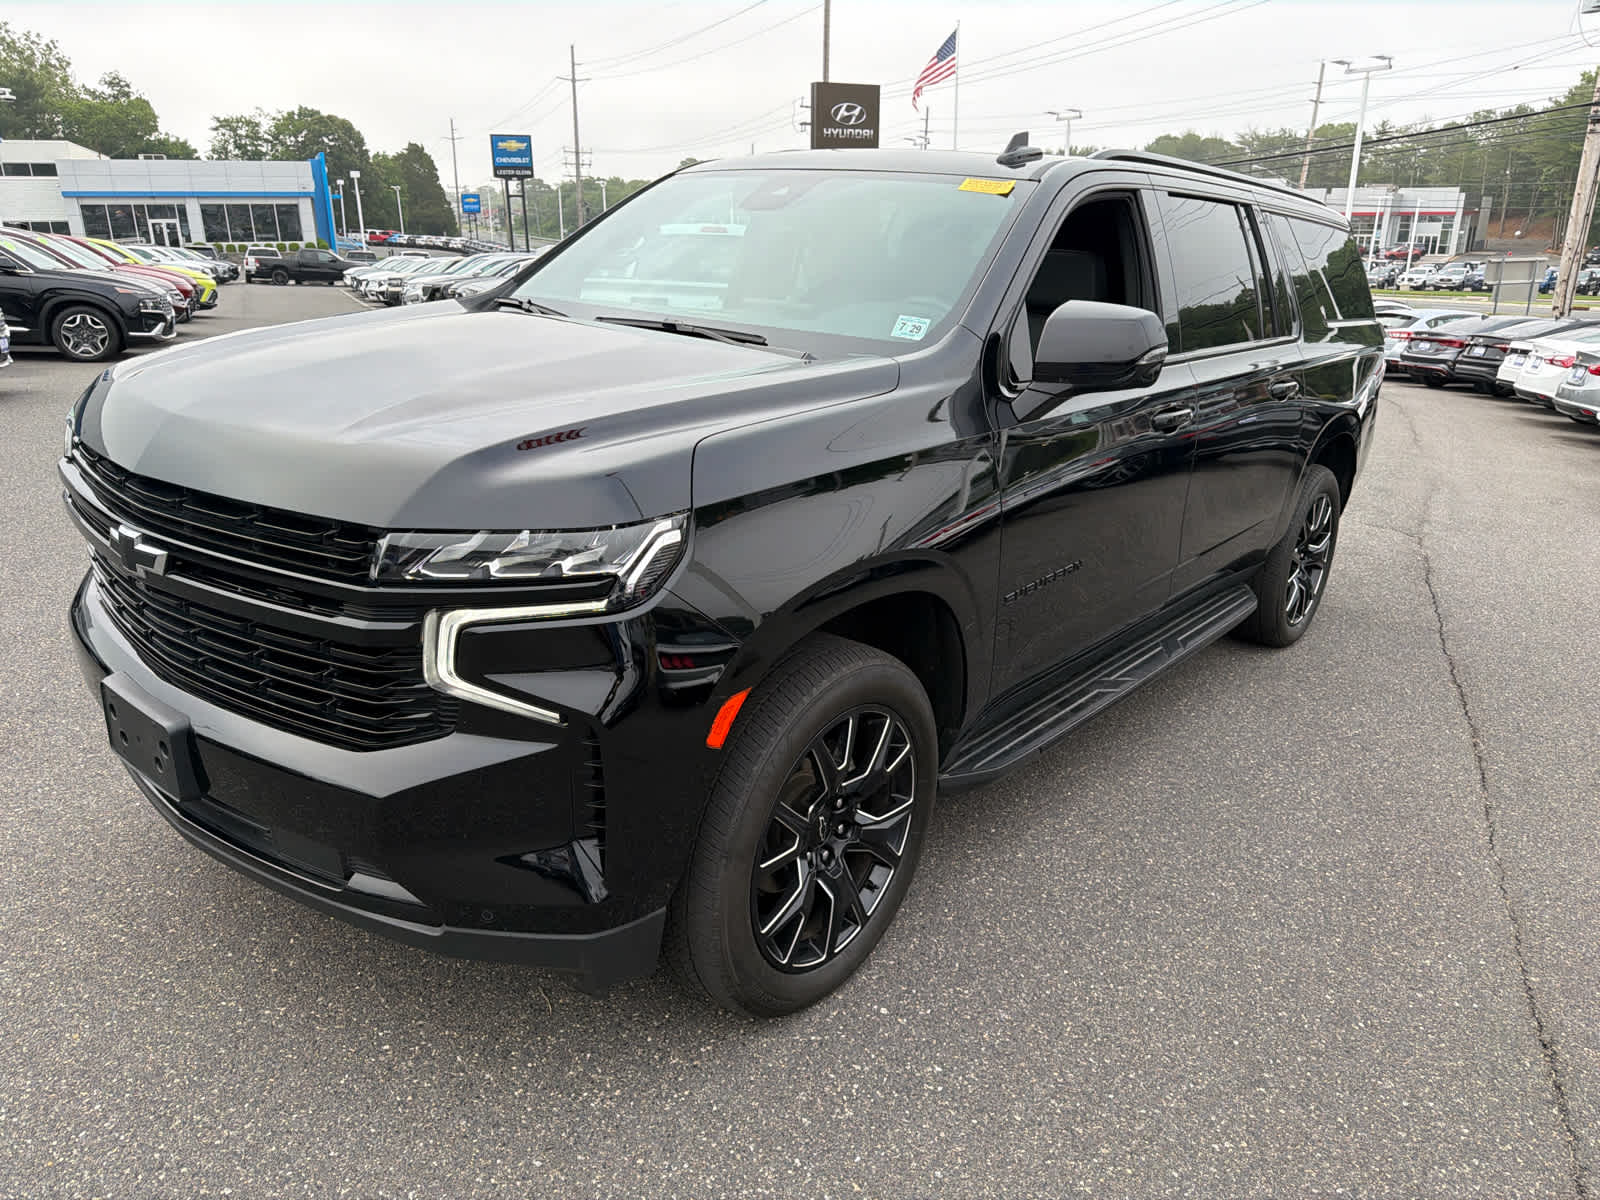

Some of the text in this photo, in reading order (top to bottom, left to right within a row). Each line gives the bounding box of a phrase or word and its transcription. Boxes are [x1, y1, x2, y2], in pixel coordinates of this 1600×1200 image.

[823, 128, 874, 140] HYUNDAI
[495, 156, 530, 164] CHEVROLET
[909, 324, 922, 334] 29
